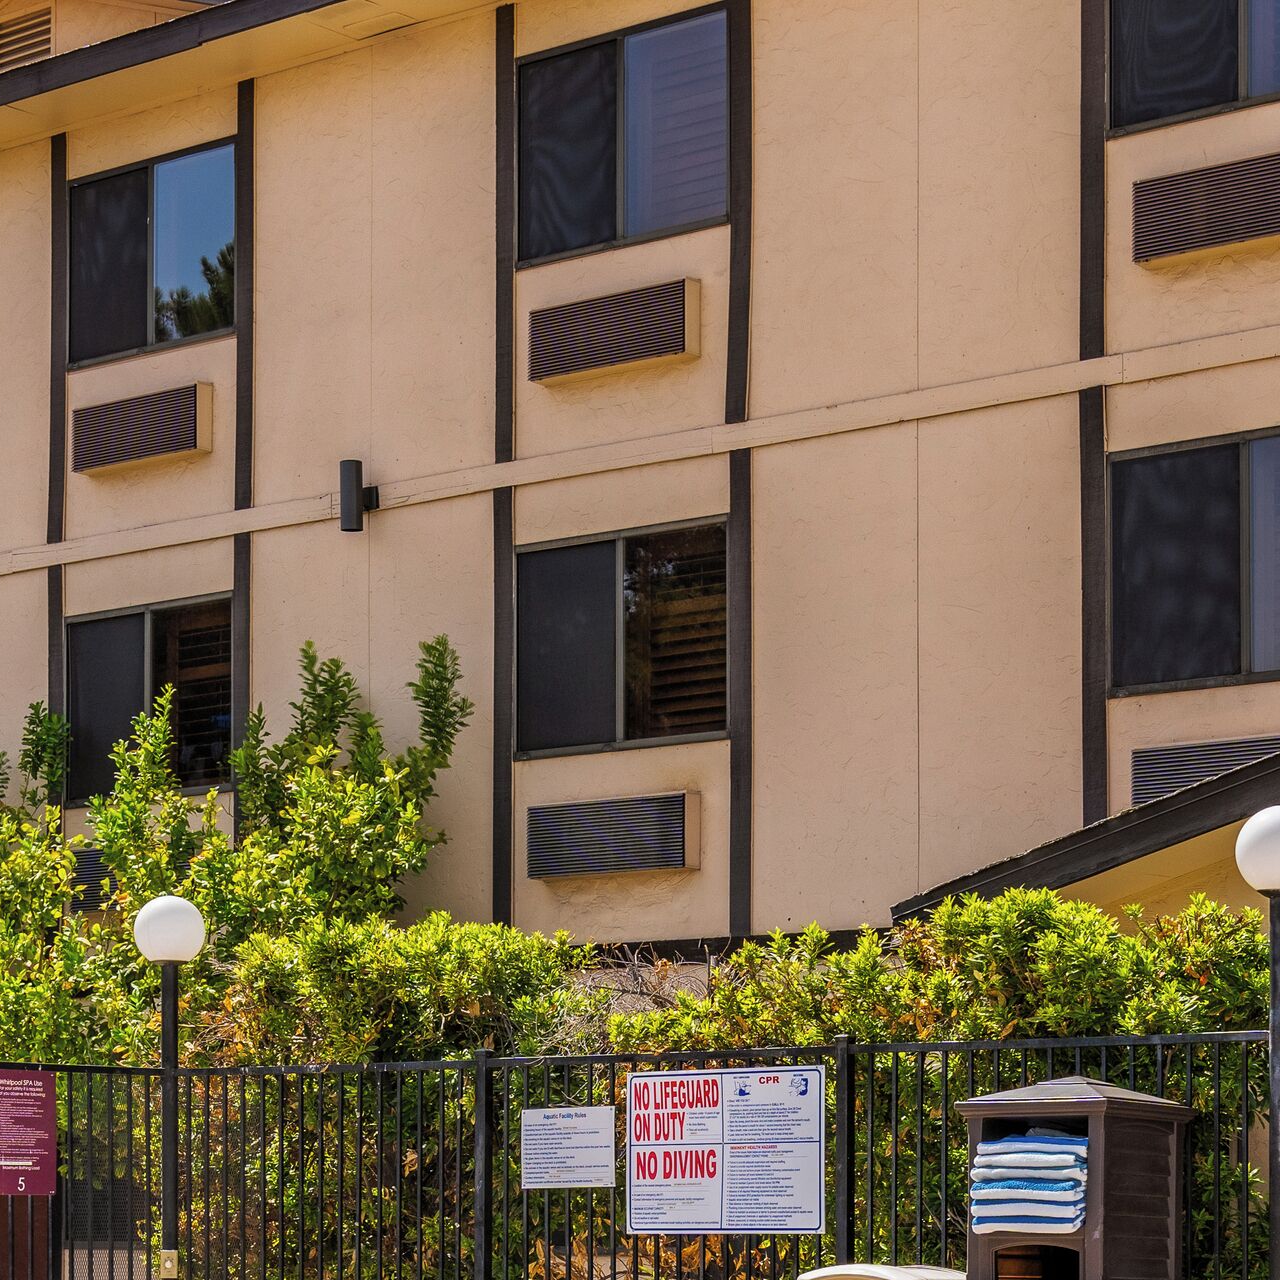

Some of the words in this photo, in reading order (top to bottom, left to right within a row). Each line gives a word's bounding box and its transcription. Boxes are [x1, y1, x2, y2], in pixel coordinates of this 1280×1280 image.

[634, 1081, 650, 1111] NO
[653, 1079, 719, 1110] LIFEGUARD
[759, 1076, 780, 1084] CPR
[635, 1113, 651, 1142] ON
[654, 1112, 685, 1141] DUTY
[636, 1151, 658, 1180] NO
[662, 1149, 716, 1180] DIVING
[18, 1177, 25, 1191] 5
